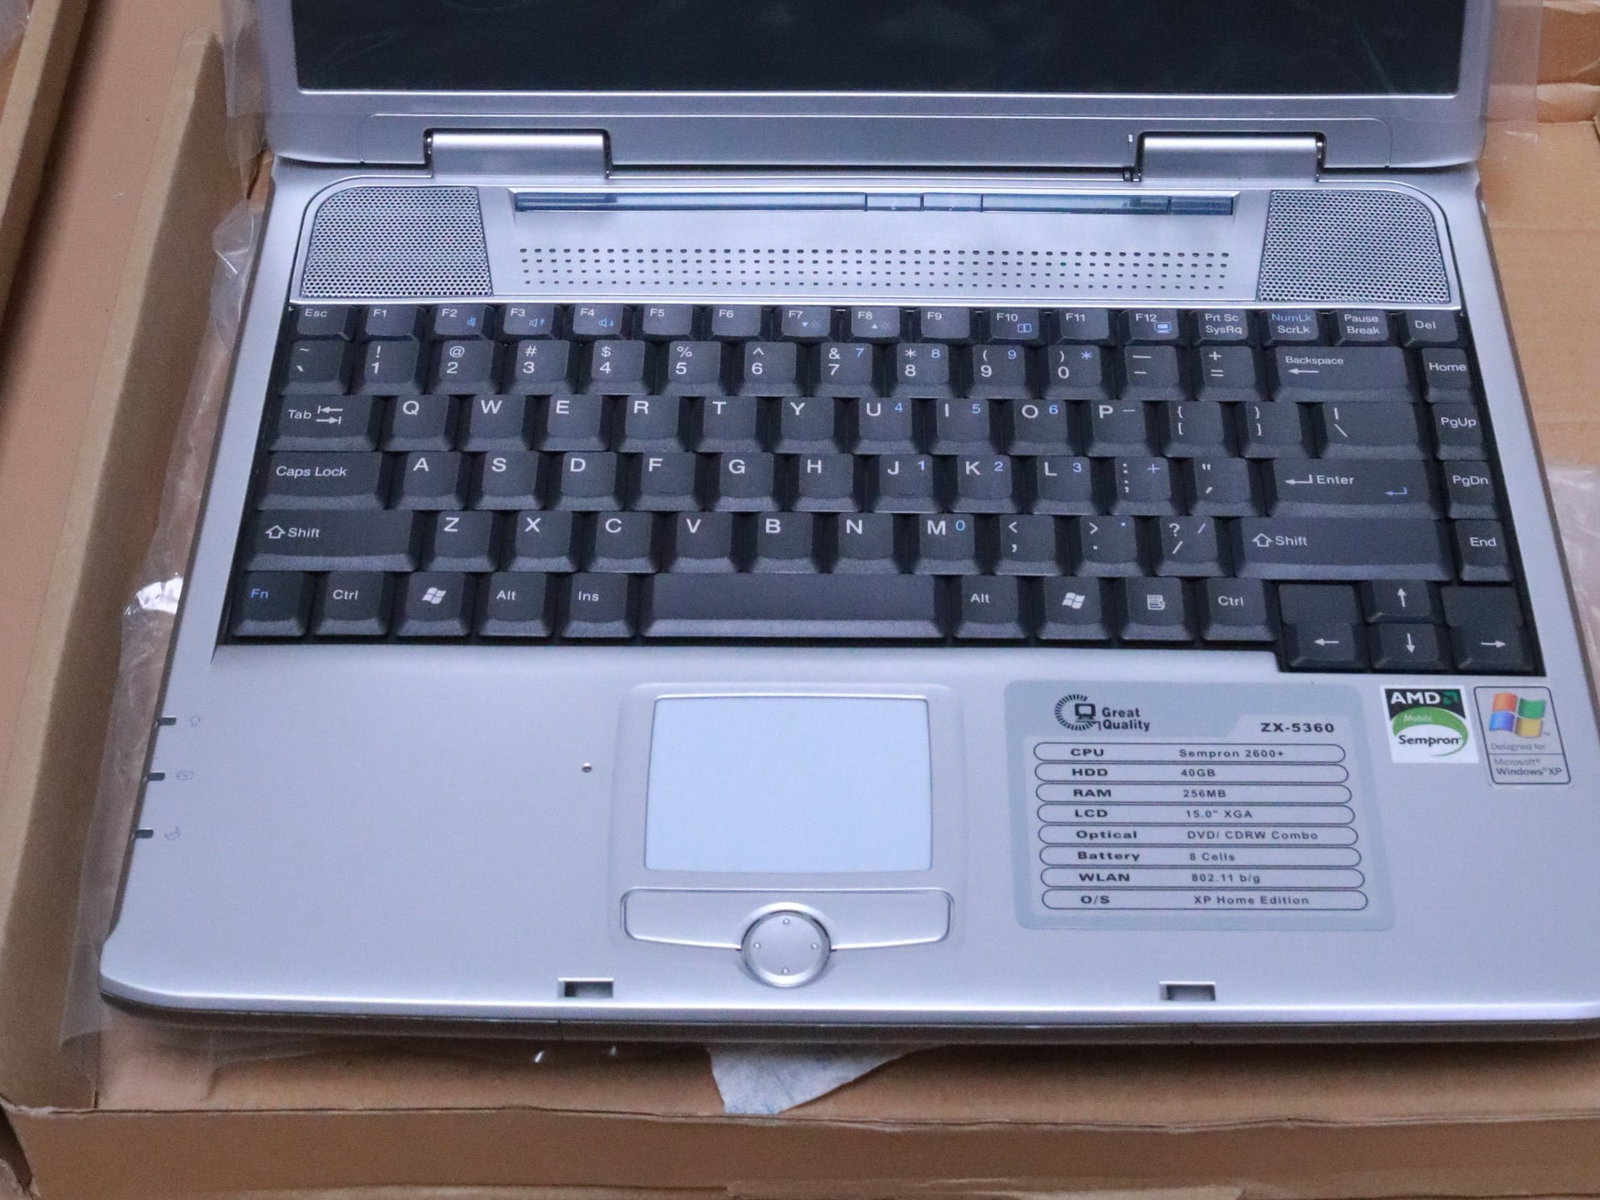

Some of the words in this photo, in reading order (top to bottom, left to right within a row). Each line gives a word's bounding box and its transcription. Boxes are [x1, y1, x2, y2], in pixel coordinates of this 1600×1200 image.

[304, 308, 328, 318] Esc
[373, 308, 387, 318] F1
[442, 308, 457, 317] F2
[510, 308, 525, 317] F3
[580, 308, 595, 317] F4
[650, 308, 664, 317] F5
[718, 309, 734, 319] F6
[789, 310, 803, 319] F7
[858, 311, 872, 320] F8
[927, 311, 942, 320] F9
[996, 313, 1018, 322] F10
[1065, 313, 1085, 322] F11
[1135, 313, 1157, 323] F12
[1271, 313, 1312, 323] NumLk
[1344, 314, 1379, 323] Pause
[1277, 325, 1310, 334] ScrLk
[1415, 320, 1436, 329] Del
[1205, 325, 1242, 336] SysRq
[1347, 326, 1380, 335] Break
[450, 346, 465, 358] @
[525, 345, 537, 356] #
[601, 345, 611, 358] $
[677, 346, 693, 358] %
[828, 348, 840, 360] &
[856, 348, 864, 357] 7
[931, 349, 940, 358] 8
[1007, 349, 1017, 359] 9
[1285, 355, 1344, 366] Backspace
[372, 362, 379, 374] 1
[446, 362, 458, 374] 2
[523, 362, 535, 374] 3
[600, 362, 611, 374] 4
[676, 362, 687, 374] 5
[752, 362, 763, 375] 6
[828, 364, 840, 376] 7
[905, 364, 916, 377] 8
[980, 365, 992, 377] 9
[1429, 362, 1467, 372] Home
[402, 401, 419, 416] Q
[481, 400, 502, 414] W
[556, 401, 570, 414] E
[633, 401, 649, 415] R
[712, 401, 727, 415] T
[790, 402, 805, 416] Y
[866, 403, 881, 416] U
[894, 403, 903, 412] 4
[972, 403, 981, 414] 5
[1049, 404, 1058, 415] 6
[1099, 405, 1113, 419] P
[288, 409, 312, 419] Tab
[1440, 417, 1476, 428] PgUp
[413, 458, 430, 471] A
[491, 458, 507, 472] S
[570, 458, 586, 472] D
[648, 458, 663, 472] F
[728, 460, 746, 474] G
[807, 460, 822, 474] H
[887, 461, 899, 475] J
[917, 460, 925, 471] 1
[965, 461, 981, 476] K
[994, 461, 1004, 472] 2
[1044, 462, 1058, 476] L
[1073, 462, 1082, 473] 3
[276, 466, 311, 477] Caps
[314, 466, 347, 476] Lock
[1316, 475, 1354, 485] Enter
[1452, 475, 1489, 487] PgDn
[444, 517, 459, 532] Z
[525, 517, 541, 533] X
[605, 518, 622, 533] C
[686, 519, 701, 533] V
[765, 520, 781, 534] B
[846, 520, 863, 535] N
[927, 520, 946, 535] M
[1169, 523, 1180, 536] ?
[287, 527, 320, 538] Shift
[1275, 536, 1308, 546] Shift
[1469, 537, 1497, 547] End
[251, 589, 269, 600] Fn
[332, 590, 359, 600] Ctrl
[496, 591, 516, 601] Alt
[970, 593, 990, 603] Alt
[1218, 596, 1244, 606] Ctrl
[1390, 691, 1441, 704] AMD
[1102, 707, 1141, 718] Great
[1102, 719, 1150, 732] Quality
[1260, 722, 1335, 733] ZX-5360
[1398, 734, 1459, 747] Sempron
[1491, 743, 1532, 751] Designed
[1070, 748, 1104, 757] CPU
[1179, 749, 1240, 759] Sempron
[1245, 749, 1284, 758] 2600+
[1072, 768, 1108, 776] HDD
[1181, 769, 1216, 777] 40GB
[1548, 767, 1562, 775] XP
[1073, 788, 1112, 798] RAM
[1183, 789, 1226, 798] 256MB
[1075, 809, 1108, 818] LCD
[1224, 810, 1253, 818] XGA
[1076, 830, 1137, 841] Optical
[1225, 831, 1266, 839] CDRW
[1271, 831, 1318, 840] Combo
[1077, 851, 1140, 862] Battery
[1189, 853, 1196, 861] 8
[1201, 852, 1235, 861] Cells
[1079, 873, 1130, 882] WLAN
[1191, 874, 1234, 882] 802.11
[1239, 874, 1261, 884] b/g
[1080, 895, 1110, 905] O/S
[1193, 896, 1212, 904] XP
[1216, 896, 1255, 904] Home
[1260, 896, 1310, 905] Edition
